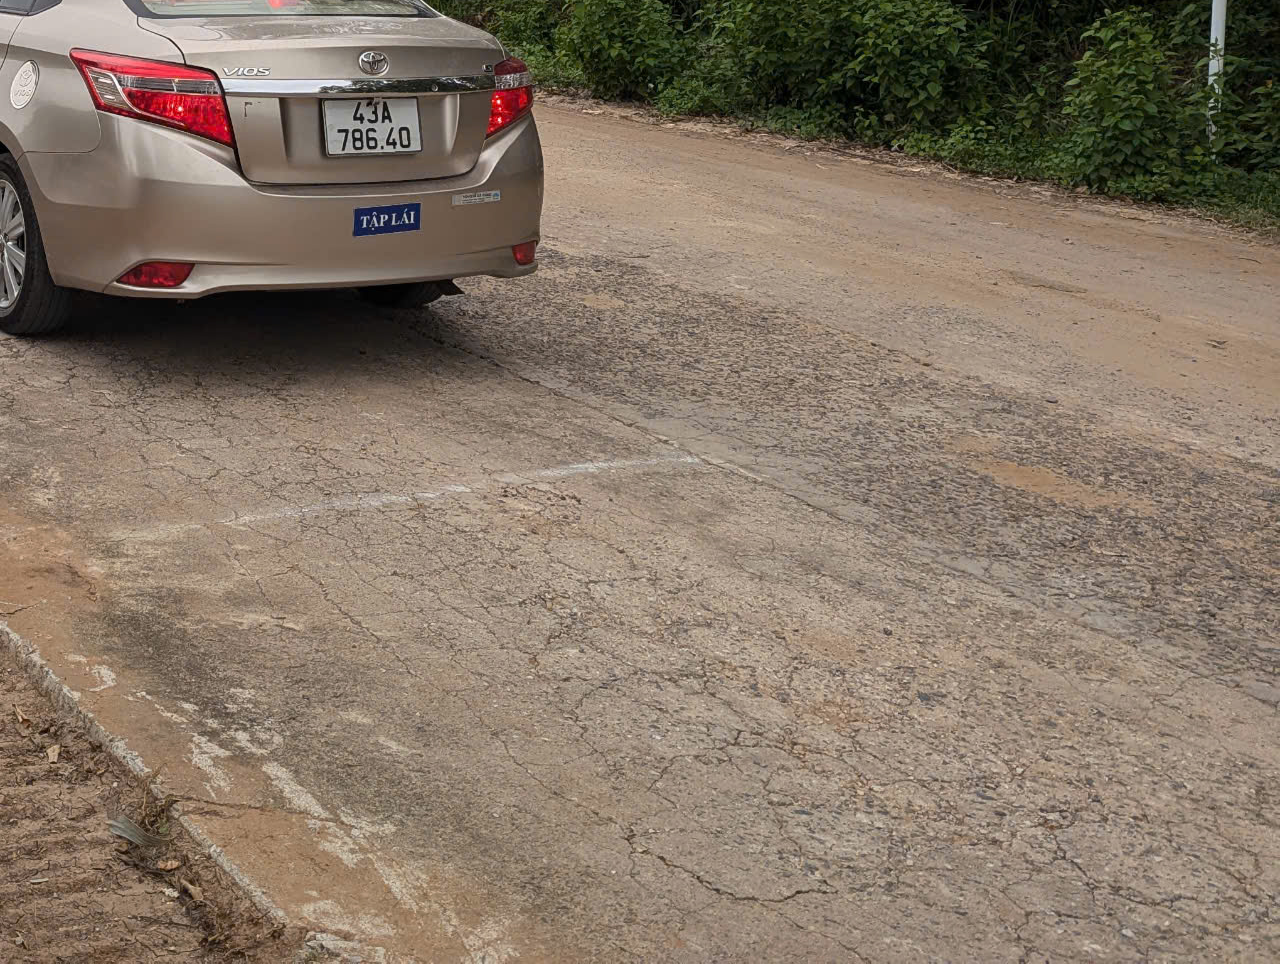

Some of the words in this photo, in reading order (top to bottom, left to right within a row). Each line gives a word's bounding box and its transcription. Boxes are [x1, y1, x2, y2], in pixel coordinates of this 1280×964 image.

[222, 67, 271, 76] VIOS
[353, 101, 392, 124] 43A
[337, 127, 411, 151] 786.40
[361, 211, 389, 231] TẬP
[391, 208, 415, 226] LÁI
